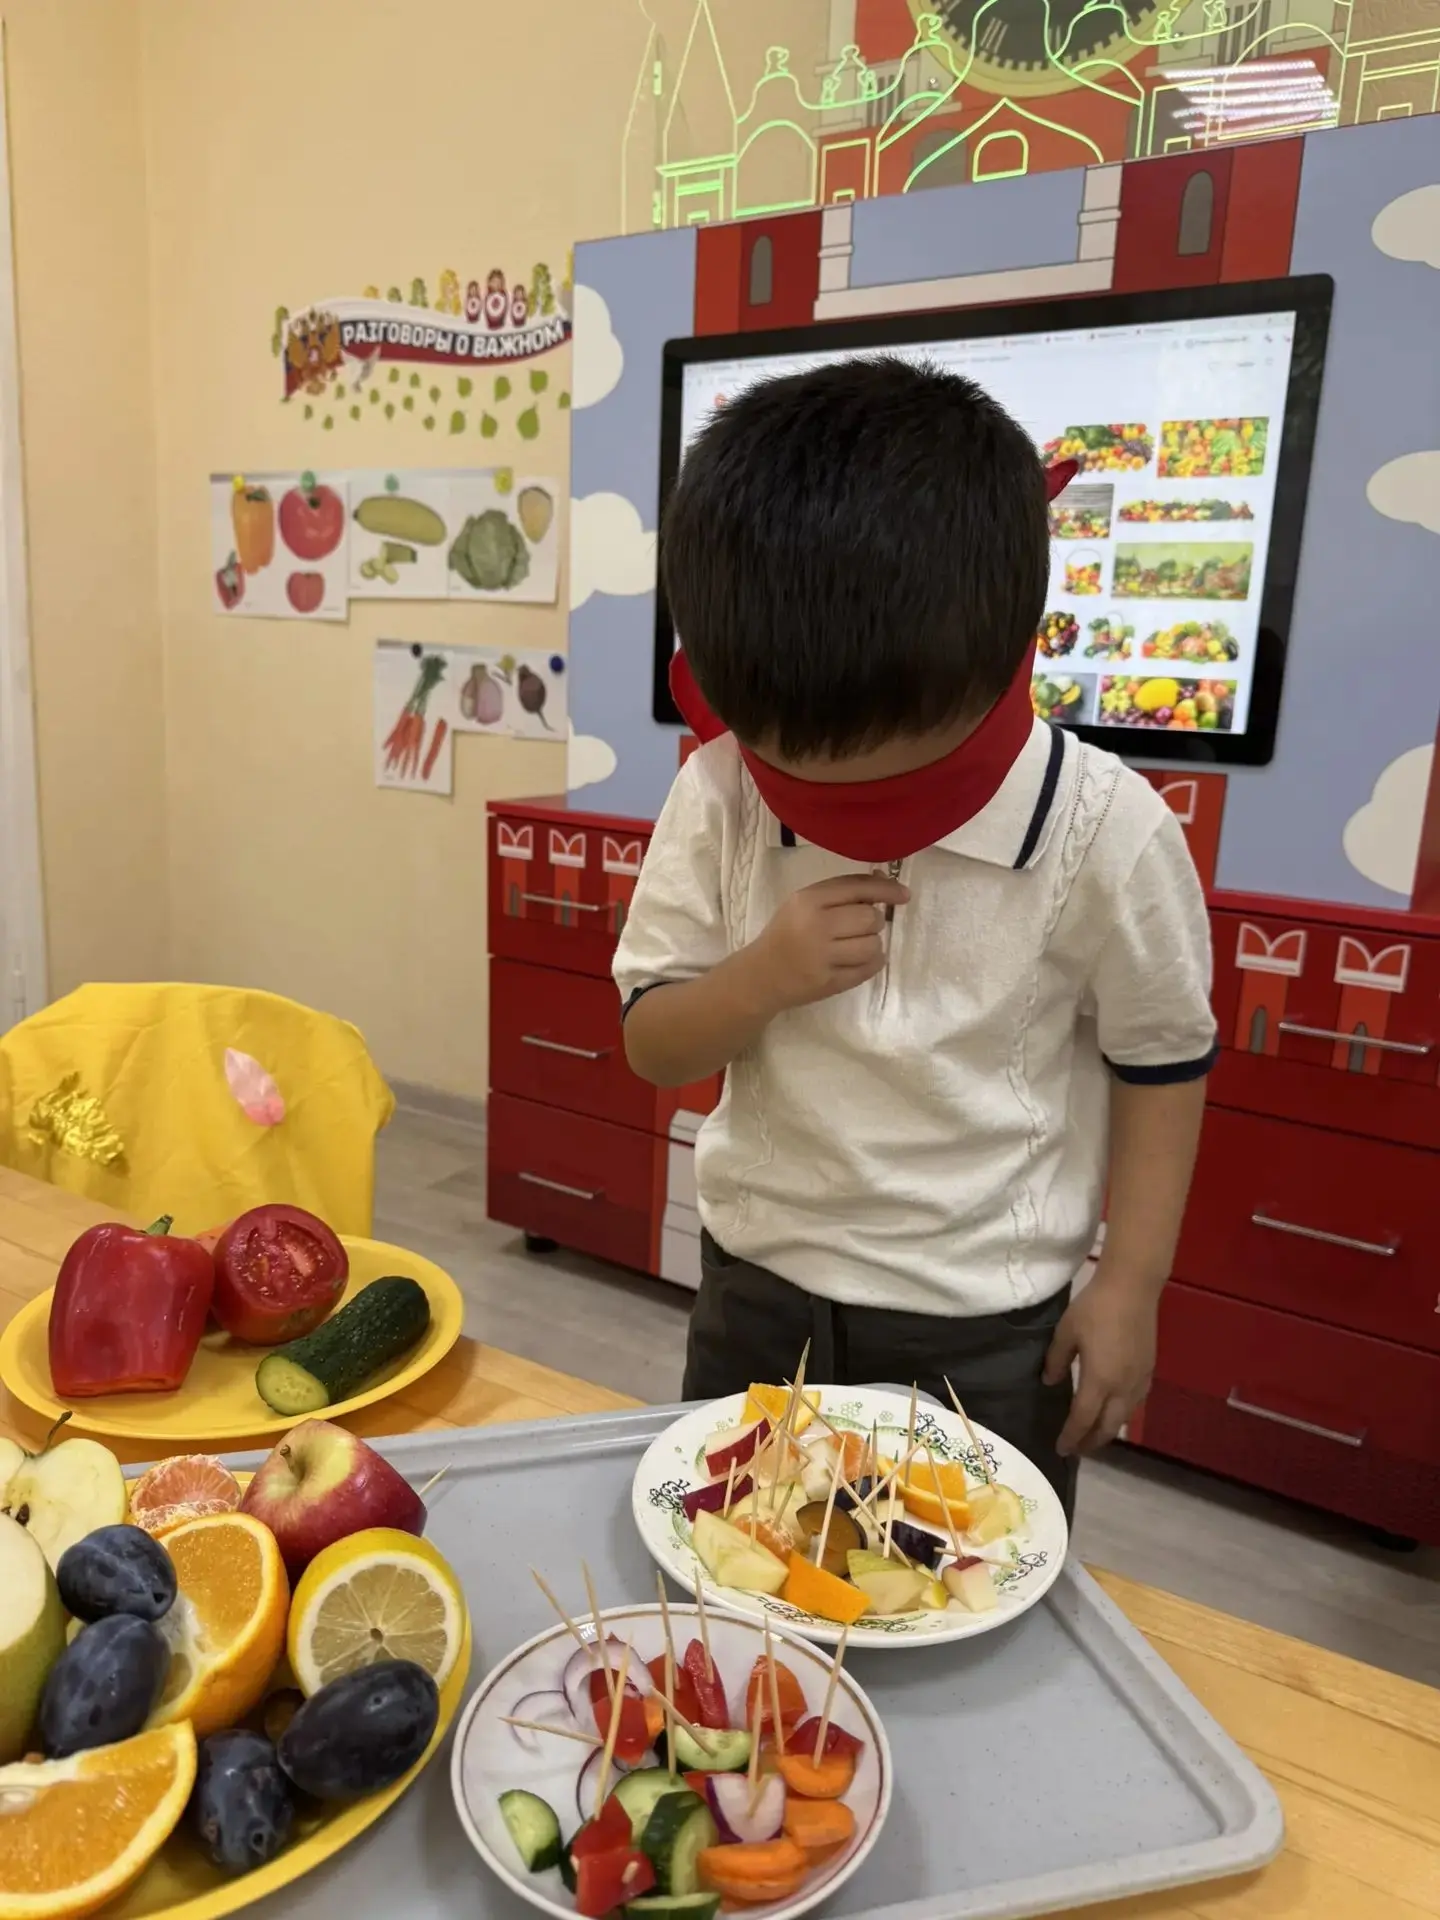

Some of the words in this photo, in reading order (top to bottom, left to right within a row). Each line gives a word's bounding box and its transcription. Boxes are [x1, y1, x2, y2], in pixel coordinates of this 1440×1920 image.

[342, 321, 451, 353] РАЗГОВОРЫ
[456, 335, 469, 356] О
[473, 319, 564, 358] ВАЖНОМ
